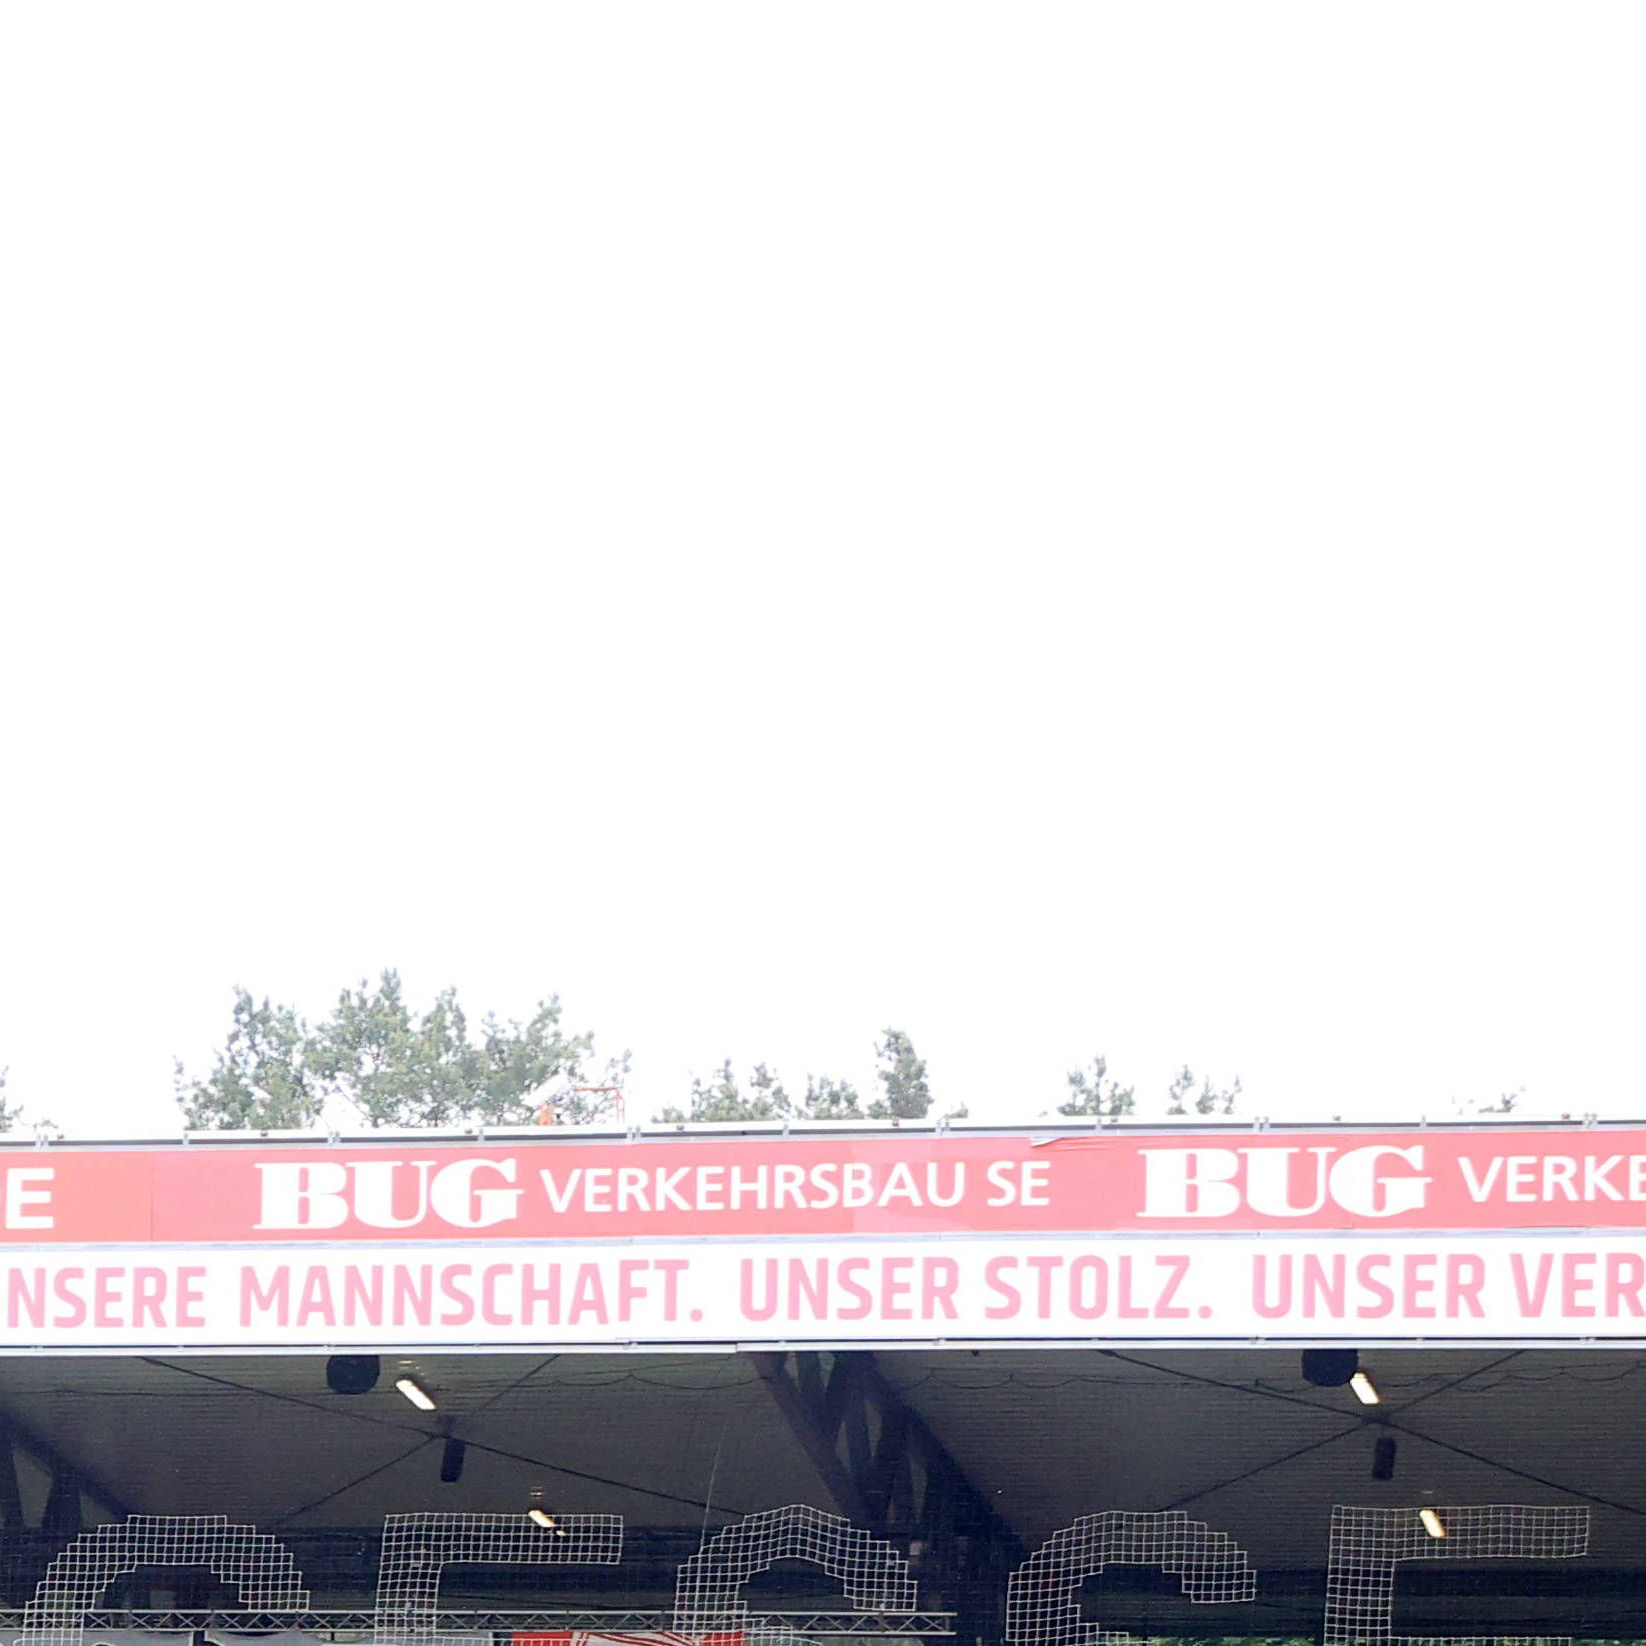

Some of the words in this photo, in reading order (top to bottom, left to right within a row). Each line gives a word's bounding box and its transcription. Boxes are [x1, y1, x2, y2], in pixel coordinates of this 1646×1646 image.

[253, 1158, 523, 1231] BUG
[539, 1161, 965, 1213] VERKEHRSBAU
[987, 1160, 1050, 1206] SE
[1137, 1144, 1434, 1218] BUG
[240, 1257, 703, 1328] MANNSCHAFT.
[740, 1255, 958, 1322] UNSER
[983, 1254, 1212, 1320] STOLZ.
[1252, 1253, 1486, 1319] UNSER
